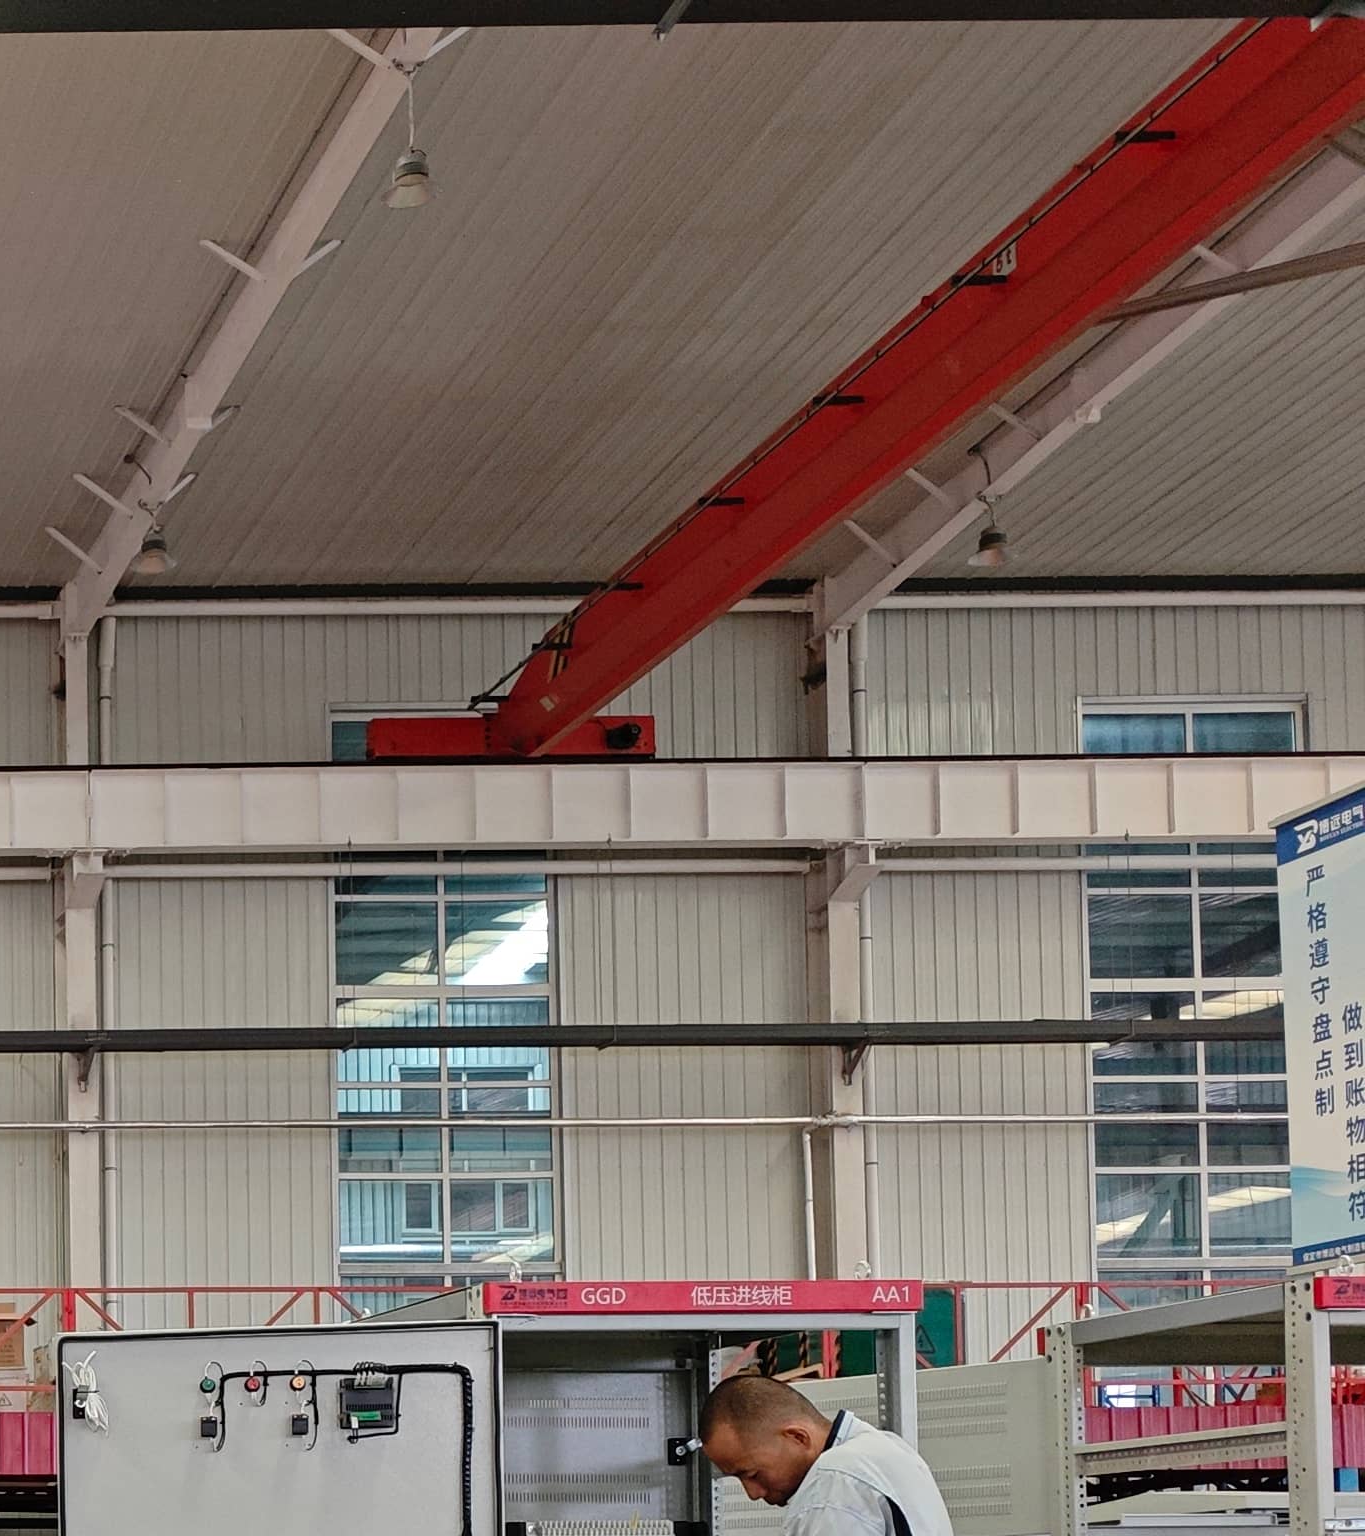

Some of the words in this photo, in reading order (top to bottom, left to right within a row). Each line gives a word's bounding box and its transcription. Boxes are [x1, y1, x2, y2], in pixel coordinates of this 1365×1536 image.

[1305, 864, 1335, 1117] 严格遵守盘点制
[1341, 1001, 1365, 1222] 做到账物相符
[581, 1287, 626, 1305] GGD
[690, 1285, 793, 1306] 低压进线柜
[871, 1287, 911, 1304] AA1
